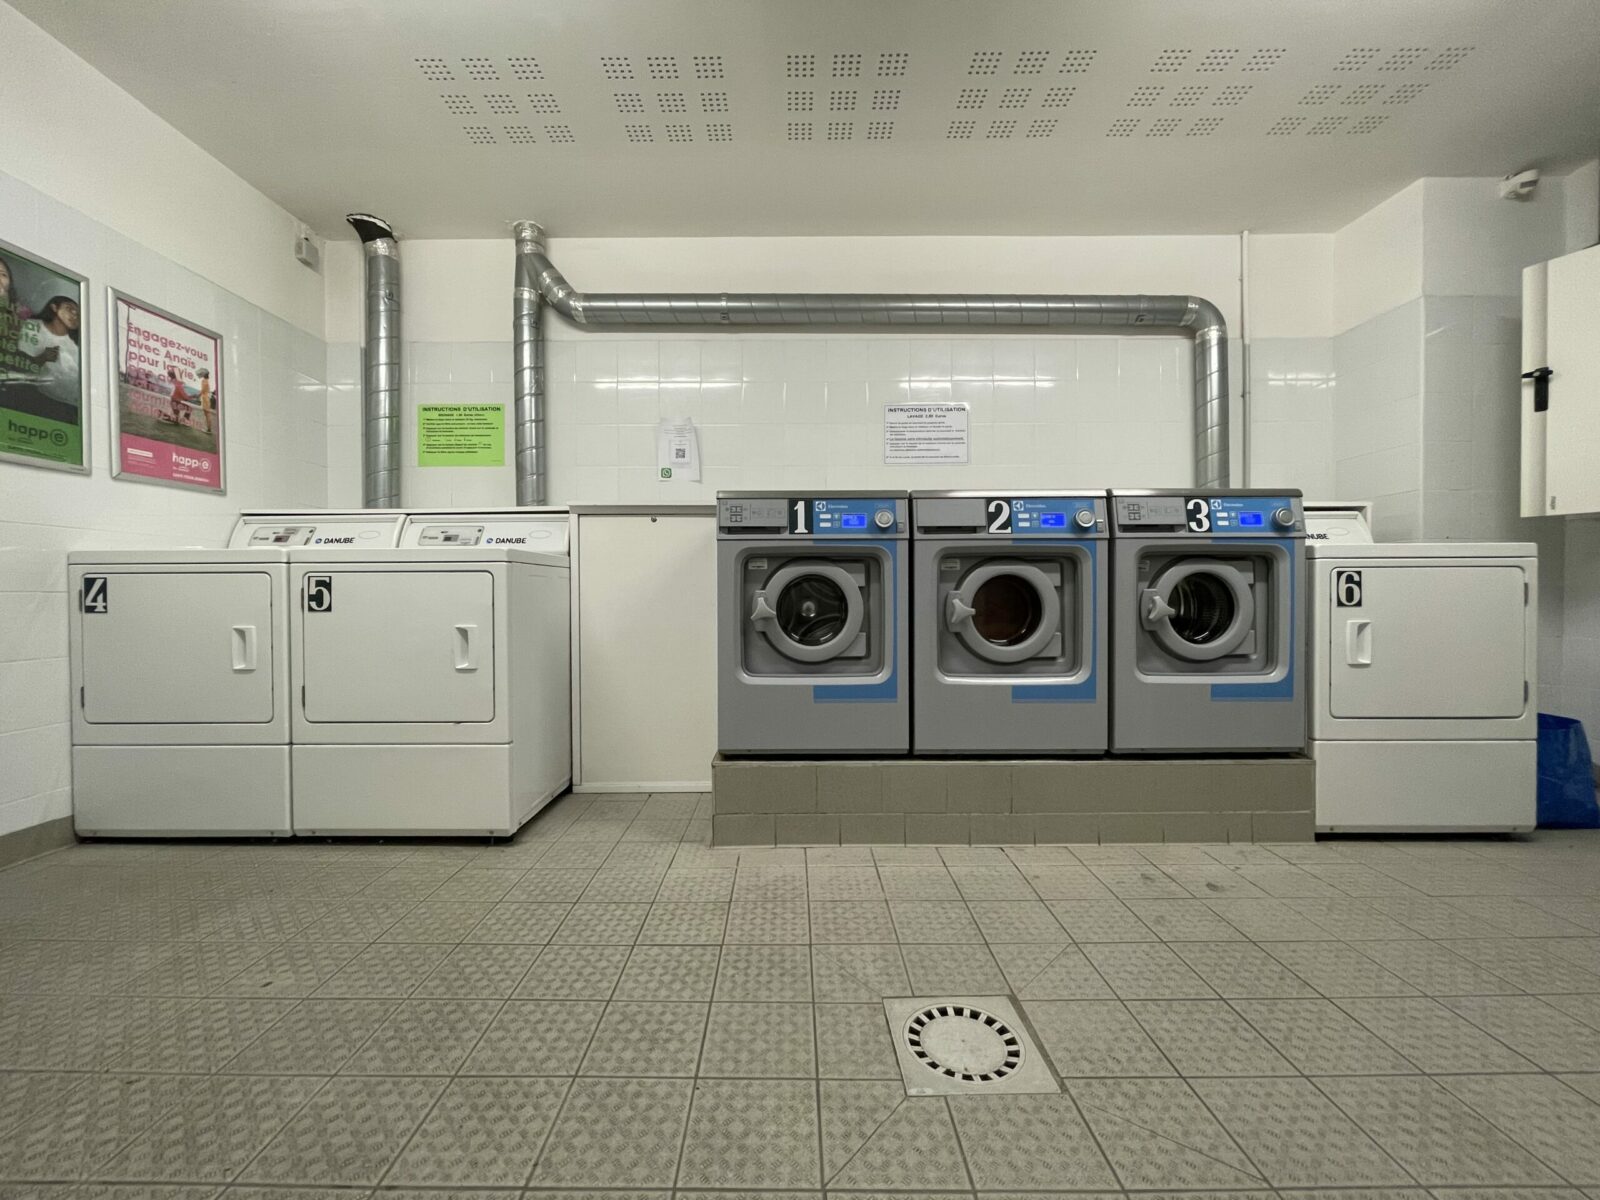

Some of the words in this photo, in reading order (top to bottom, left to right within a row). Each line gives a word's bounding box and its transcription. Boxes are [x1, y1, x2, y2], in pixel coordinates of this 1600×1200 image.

[128, 323, 208, 361] Engagez-vous
[128, 339, 160, 356] avec
[164, 350, 196, 369] Anaïs
[129, 351, 159, 367] pour
[793, 500, 809, 534] 1
[987, 500, 1012, 533] 2
[1187, 498, 1210, 532] 3
[85, 578, 106, 612] 4
[308, 576, 331, 611] 5
[1337, 571, 1361, 606] 6
